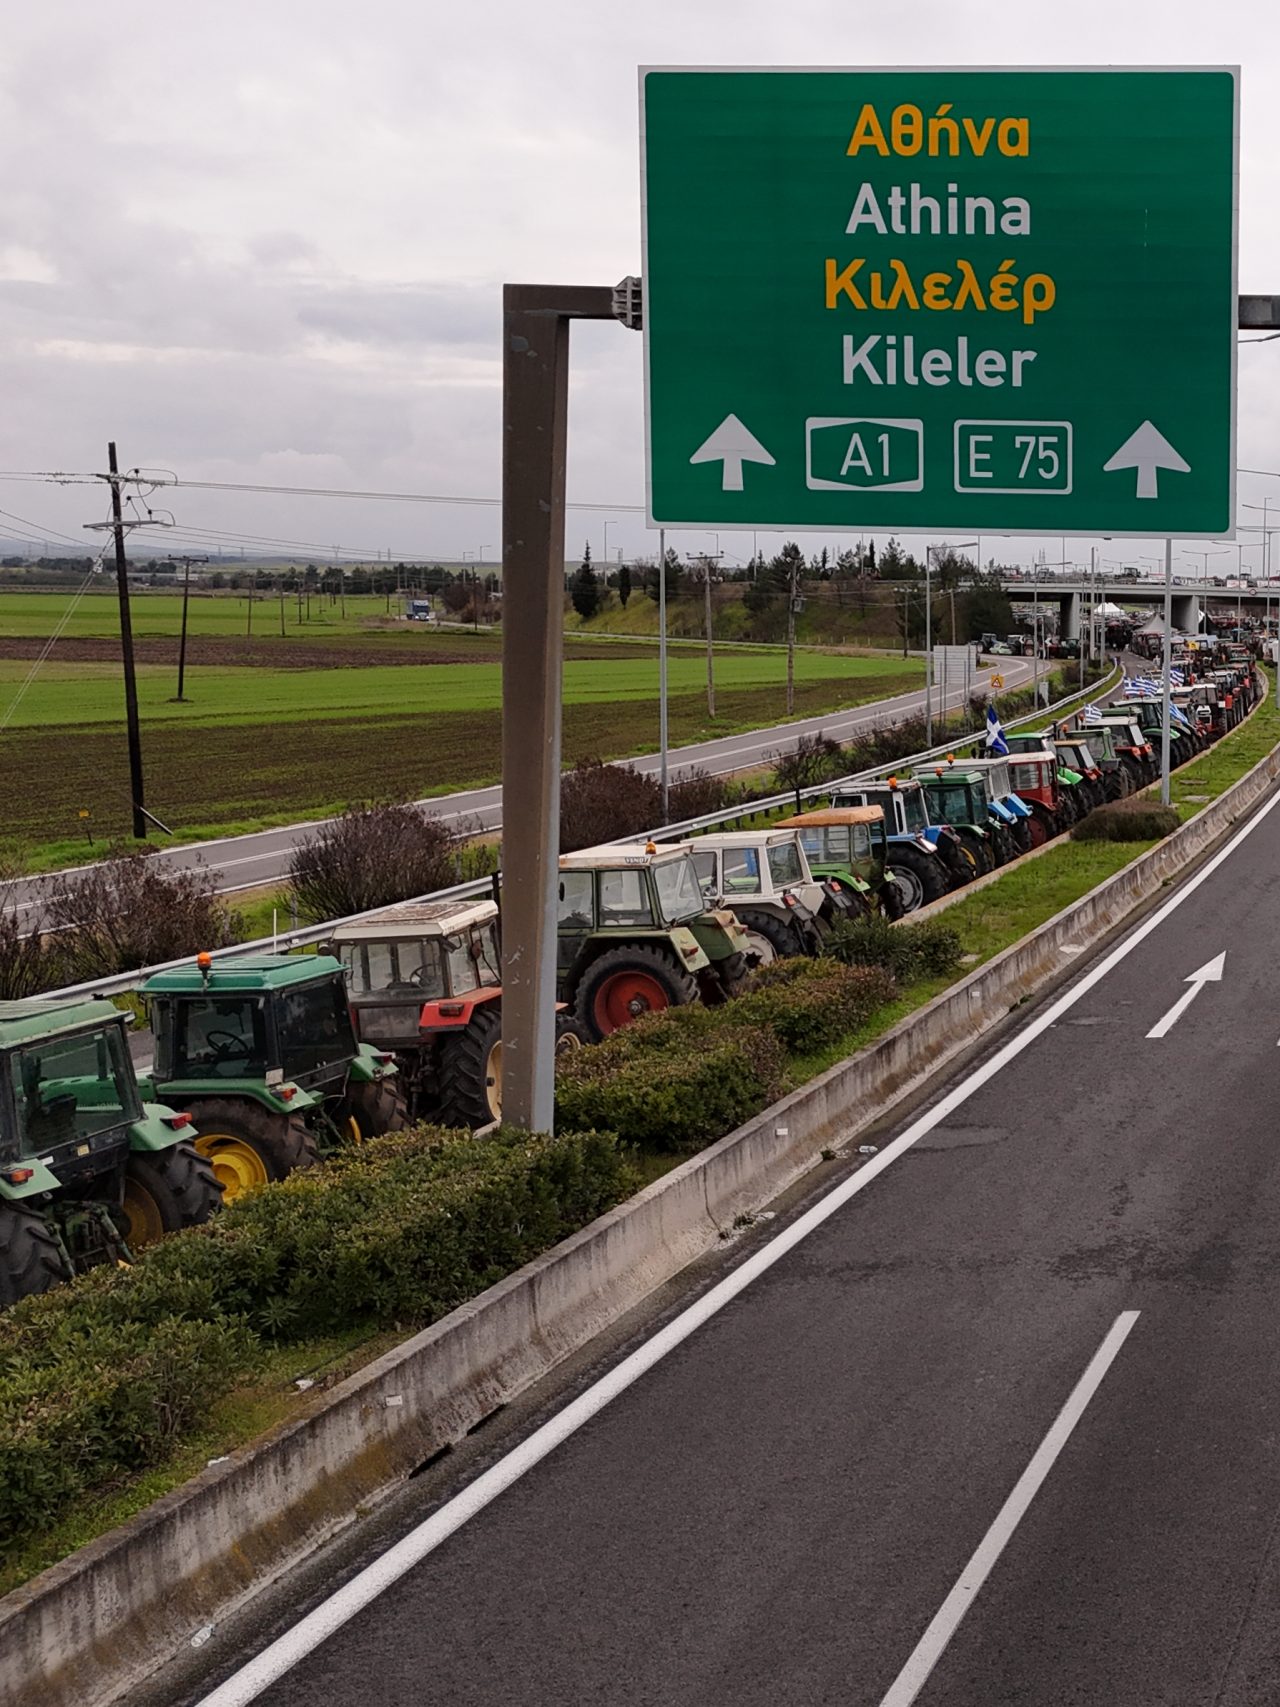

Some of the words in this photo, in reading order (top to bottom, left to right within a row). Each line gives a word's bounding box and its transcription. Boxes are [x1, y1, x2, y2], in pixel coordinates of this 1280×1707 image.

[847, 104, 1029, 156] Αθήνα
[846, 183, 1030, 235] Athina
[826, 259, 1055, 324] Κιλελέρ
[844, 335, 1037, 386] Kileler
[841, 433, 890, 476] A1
[969, 436, 993, 478] E
[1015, 436, 1059, 479] 75
